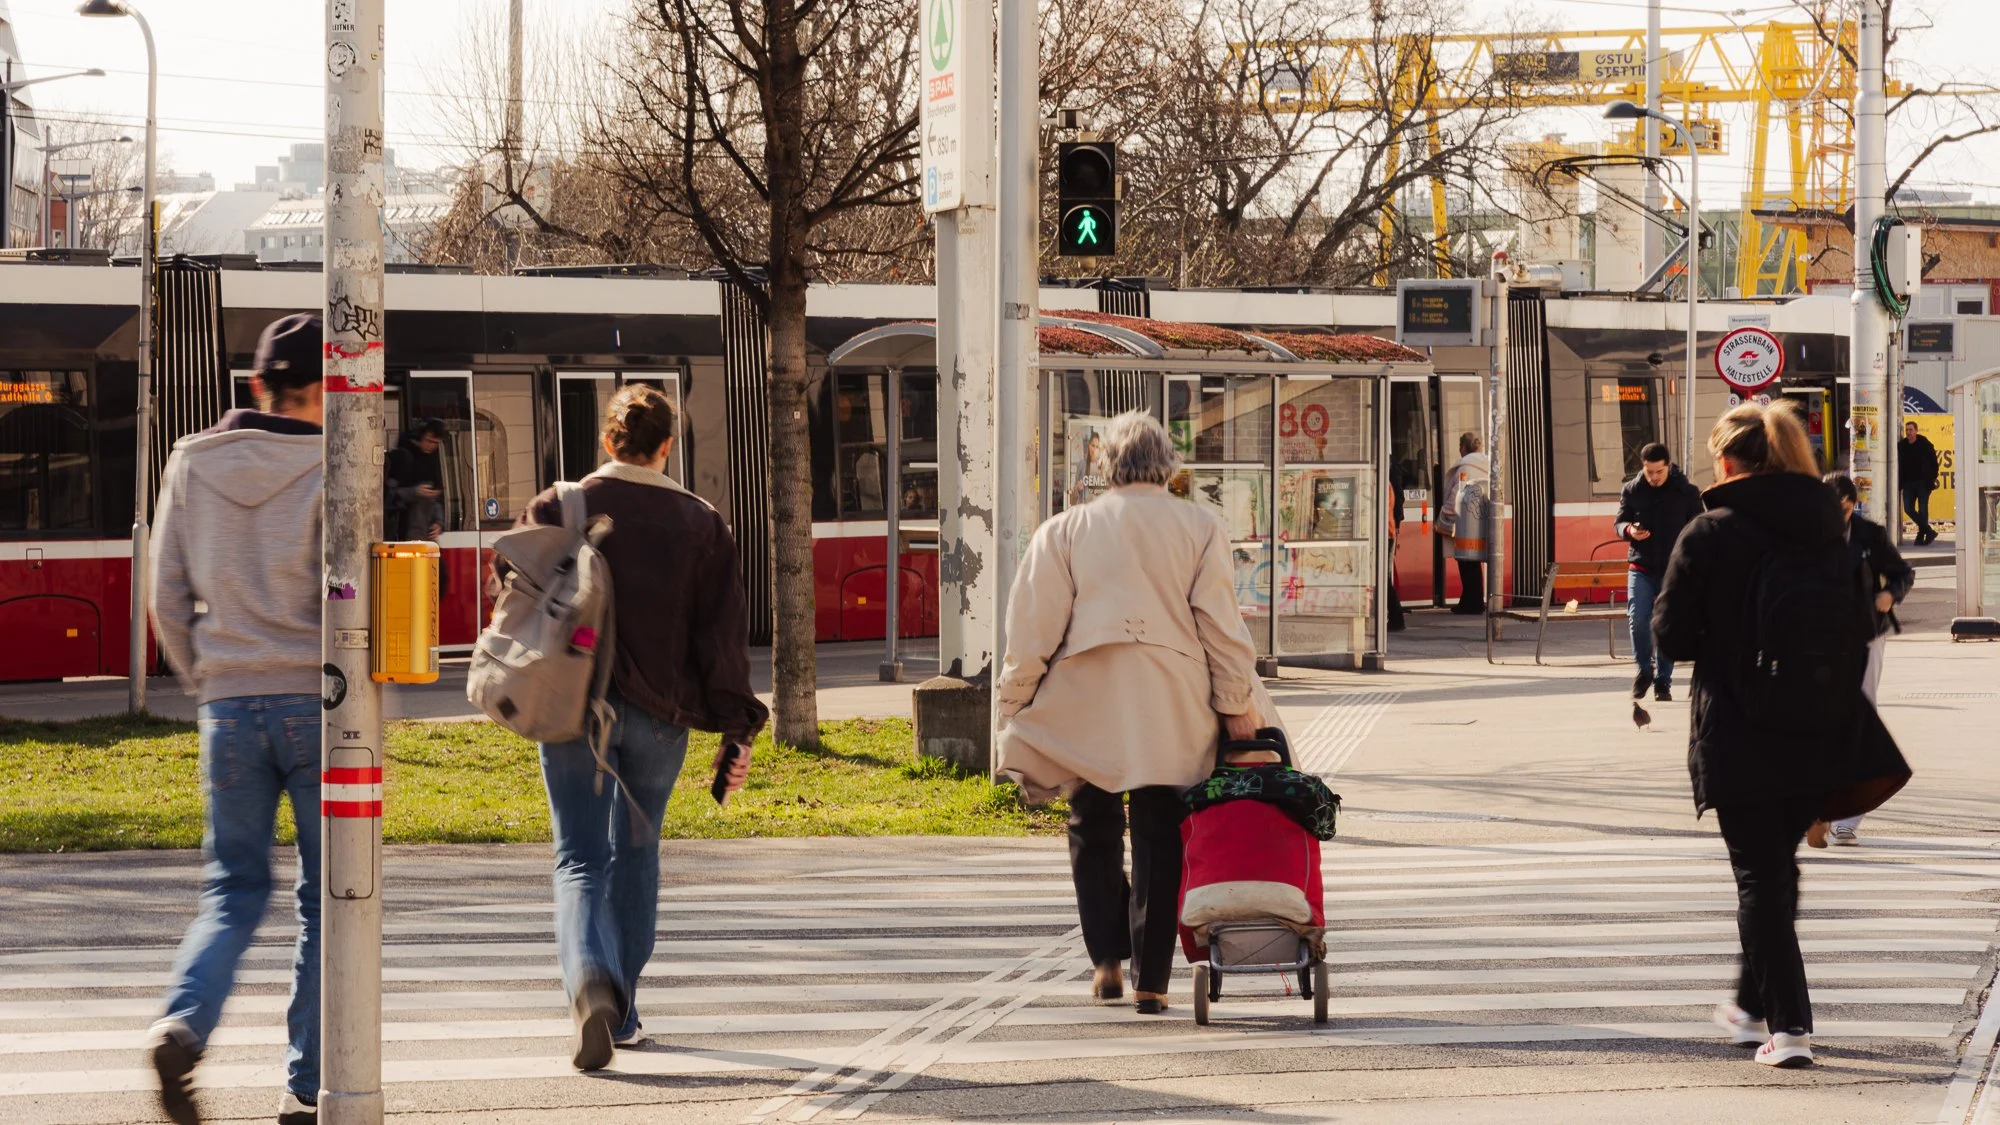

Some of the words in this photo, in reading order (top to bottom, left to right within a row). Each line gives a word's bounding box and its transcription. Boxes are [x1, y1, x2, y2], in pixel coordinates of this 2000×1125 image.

[928, 76, 954, 101] SPAR
[1723, 334, 1776, 356] STRASSENBAHN
[1725, 364, 1773, 383] HALTESTELLE
[1730, 396, 1736, 406] 6
[1760, 396, 1769, 406] 18
